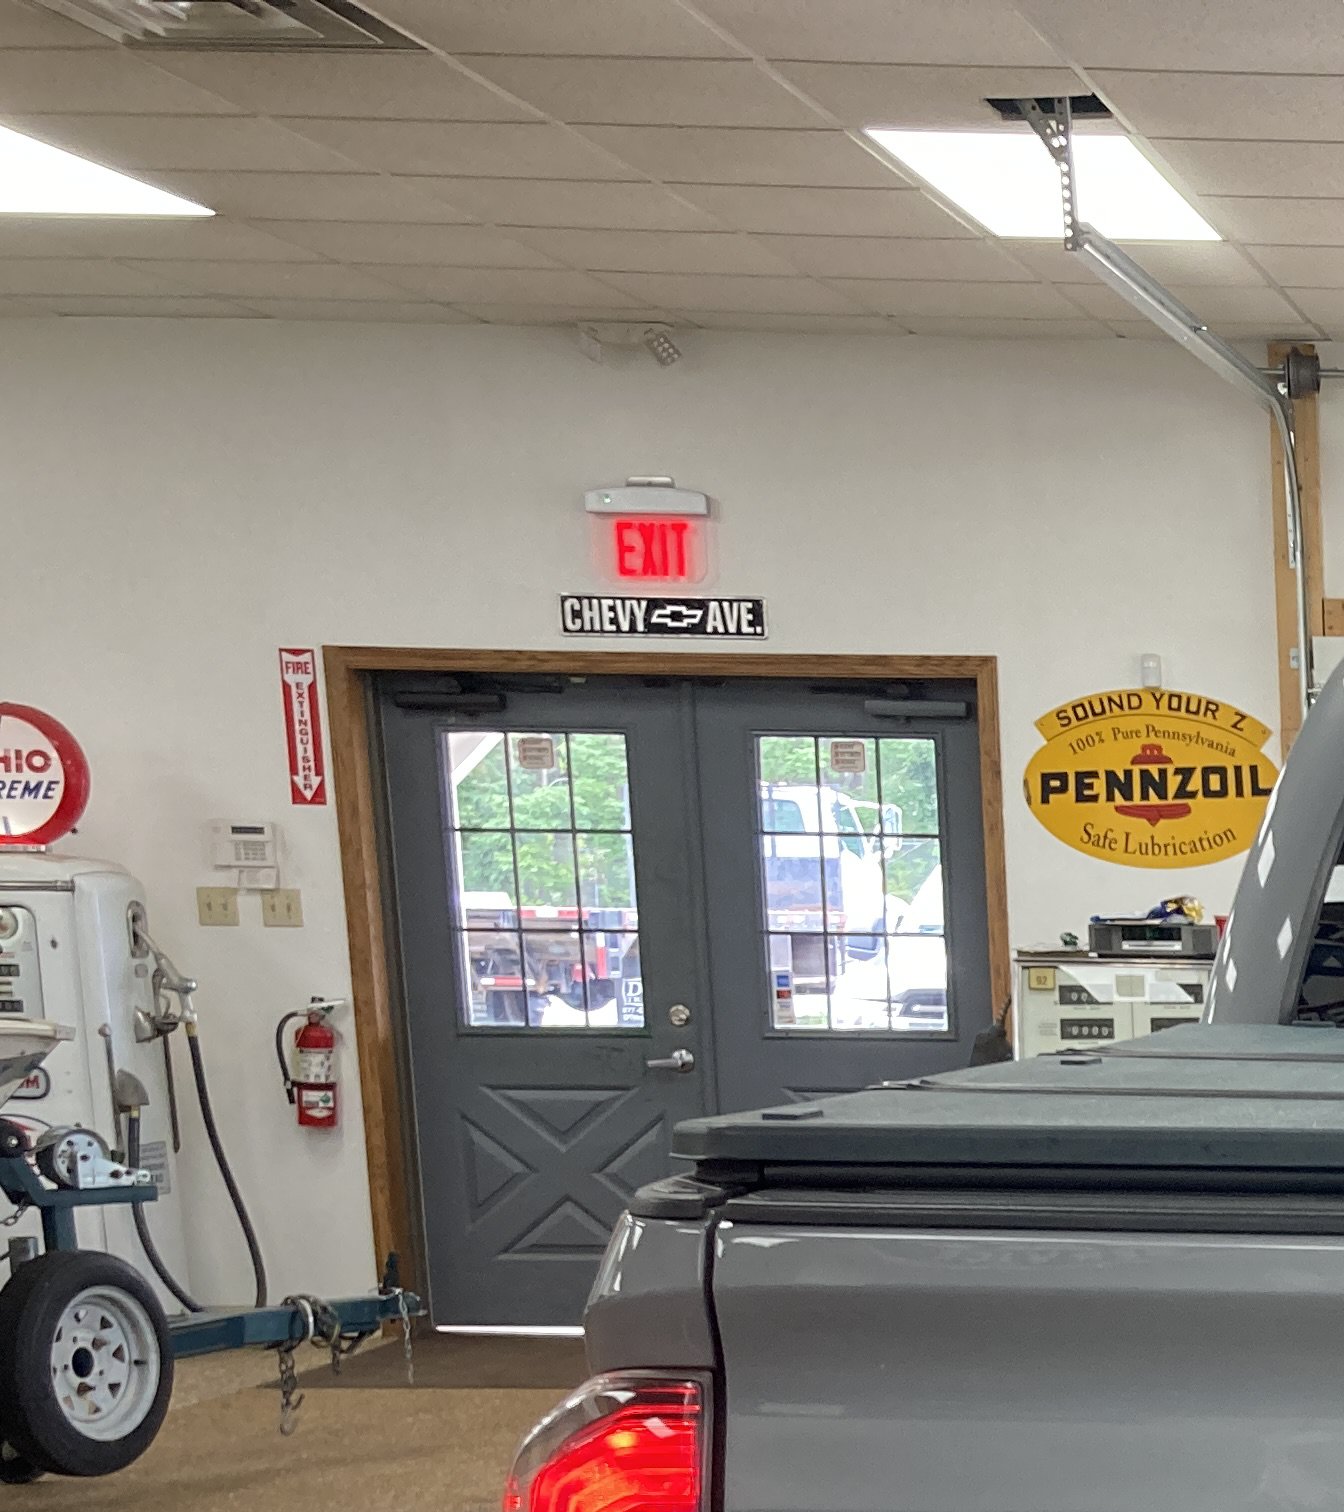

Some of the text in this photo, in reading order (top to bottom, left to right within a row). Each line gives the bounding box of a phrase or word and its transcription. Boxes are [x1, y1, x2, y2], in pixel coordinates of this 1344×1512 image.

[616, 521, 688, 577] EXIT
[562, 598, 763, 634] CHEVY AVE.
[284, 661, 311, 675] FIRE
[1055, 691, 1143, 728] SOUND
[1149, 691, 1220, 721] YOUR
[295, 681, 313, 791] EXTINGUISHER
[1068, 723, 1237, 758] 100% Pure Pennsylvania
[1039, 764, 1273, 805] PENNZOIL
[1079, 821, 1238, 858] Safe Lubrication
